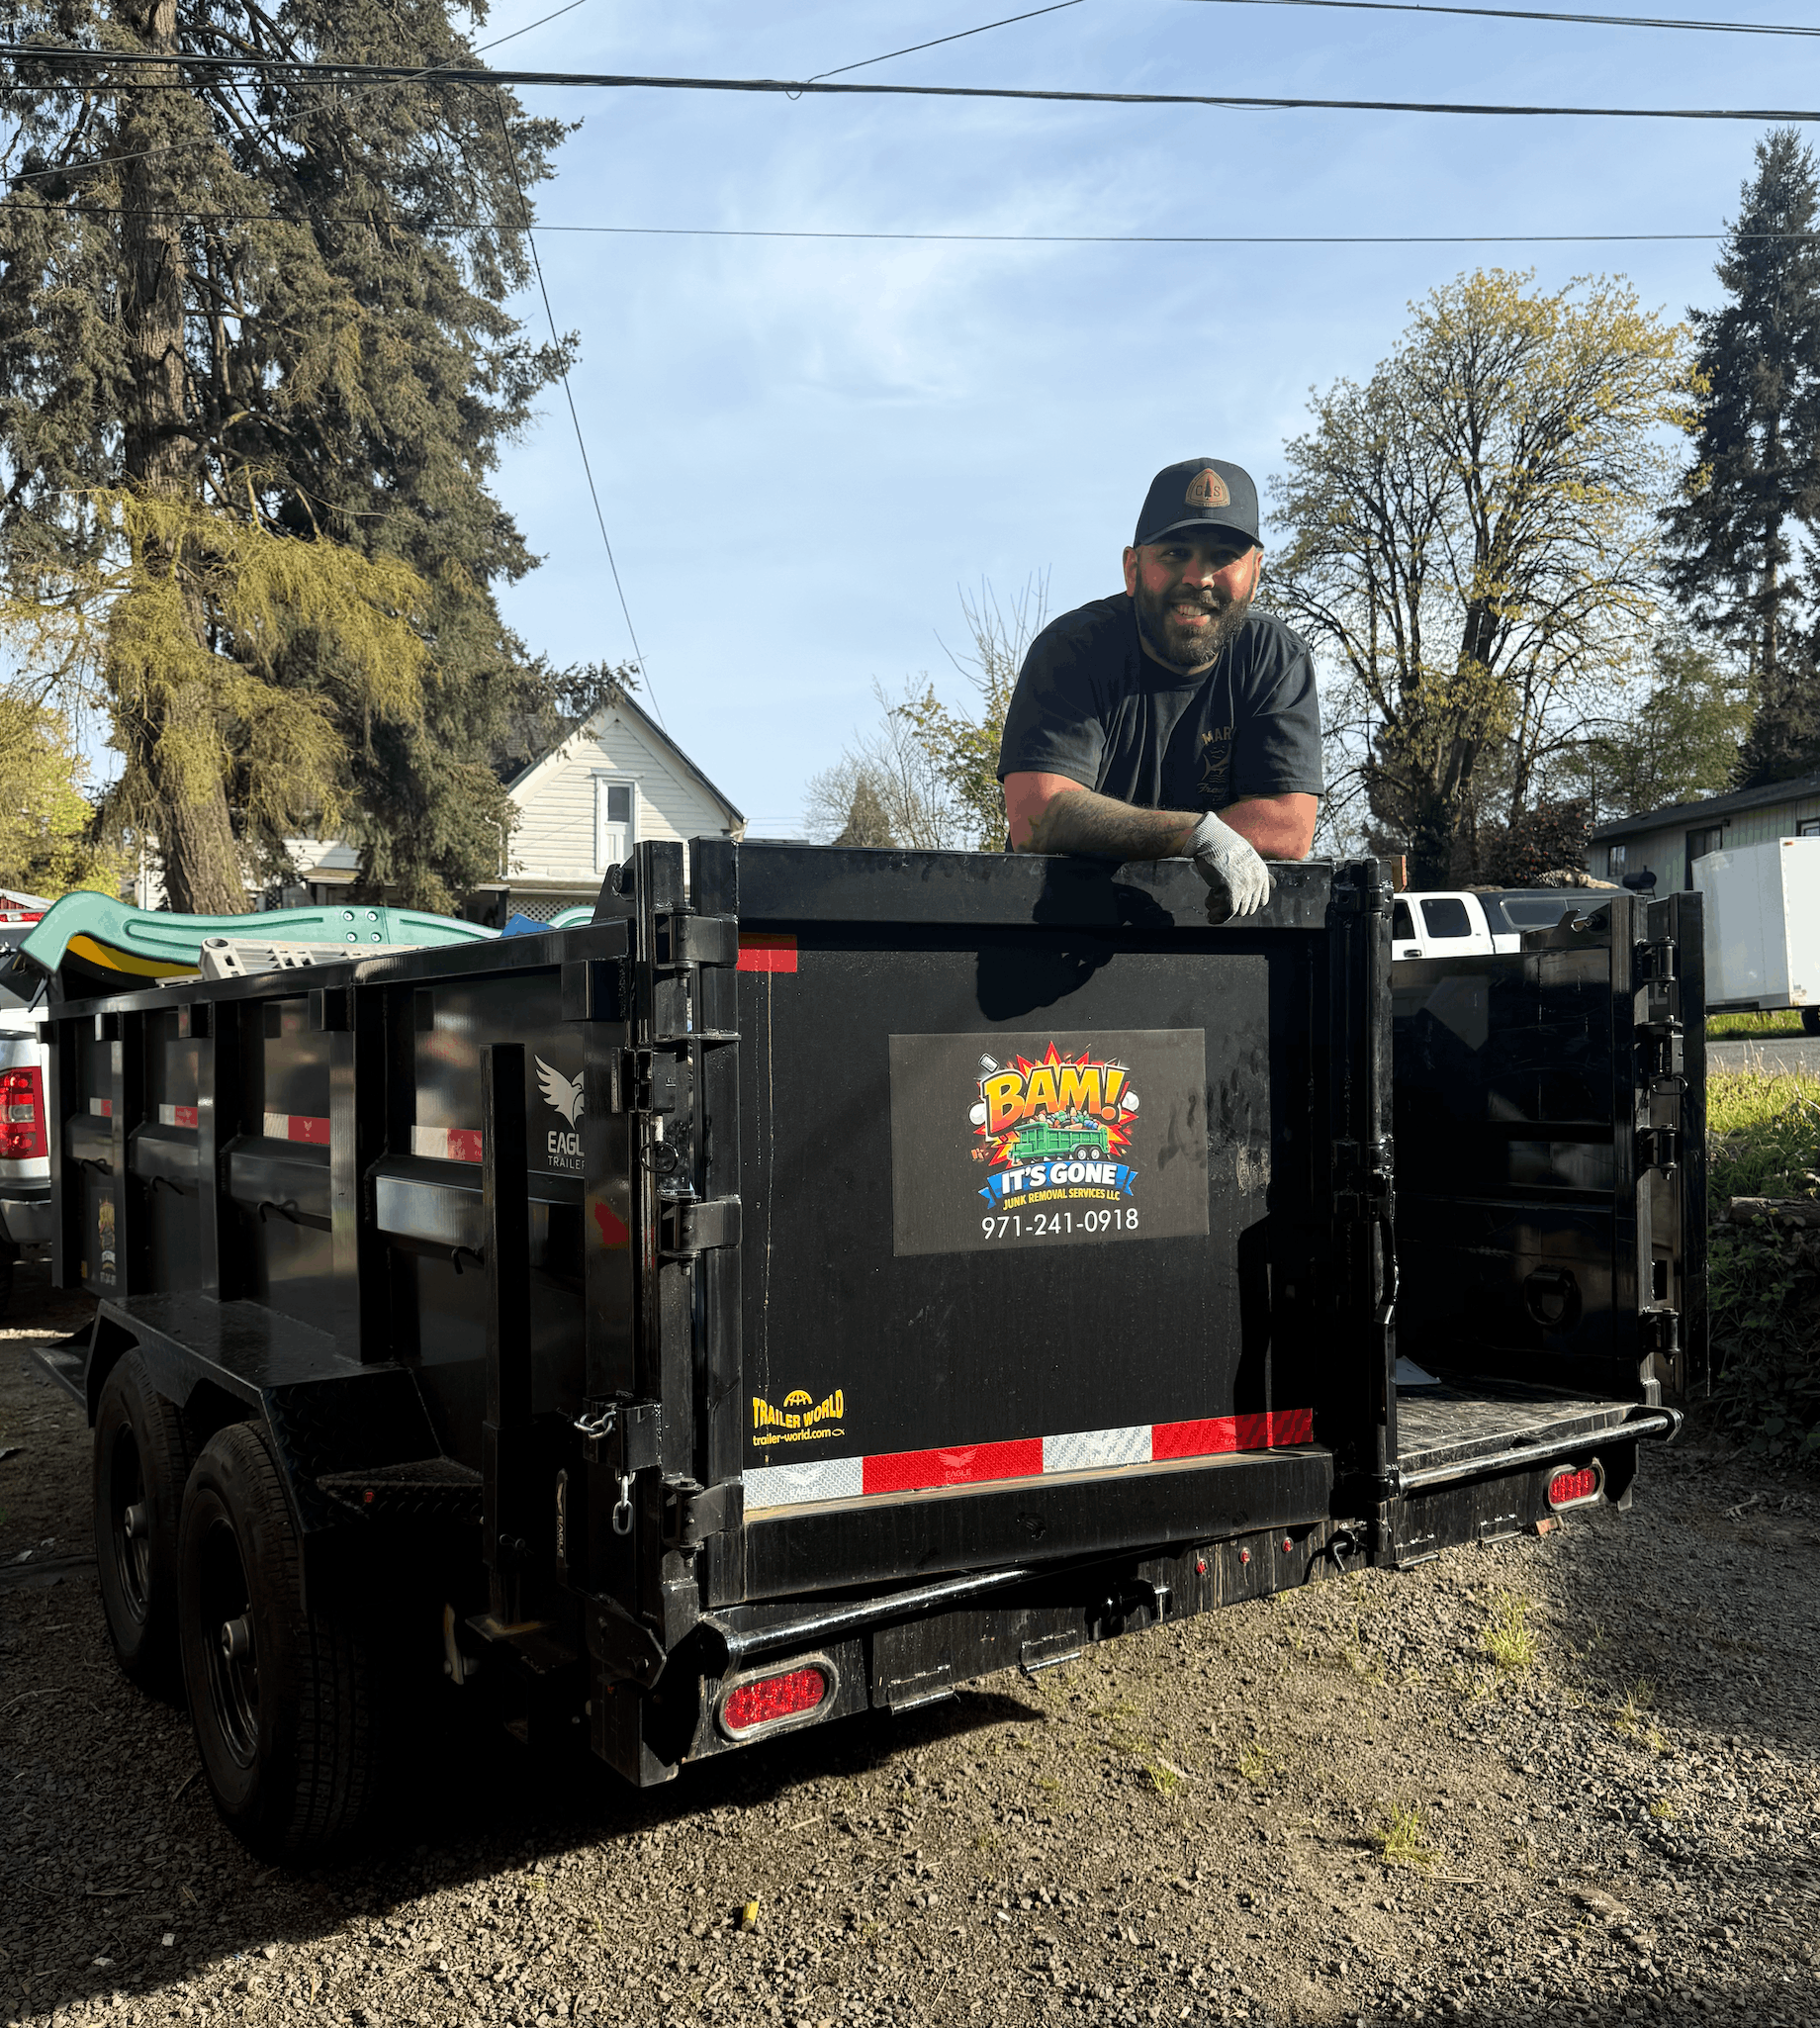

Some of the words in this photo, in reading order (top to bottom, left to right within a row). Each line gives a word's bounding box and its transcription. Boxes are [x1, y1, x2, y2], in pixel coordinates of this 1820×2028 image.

[1213, 485, 1221, 497] S
[983, 1064, 1128, 1136] BAM!
[1001, 1164, 1046, 1194] IT'S
[1049, 1162, 1118, 1185] GONE
[1002, 1194, 1027, 1211] JUNK
[1028, 1188, 1068, 1204] REMOVAL
[1068, 1187, 1106, 1199] SERVICES
[1106, 1189, 1121, 1202] LLC
[981, 1207, 1139, 1240] 971-241-0918
[752, 1396, 801, 1429] TRAILER
[802, 1388, 845, 1429] WORLD
[752, 1428, 832, 1446] trailer-world.com
